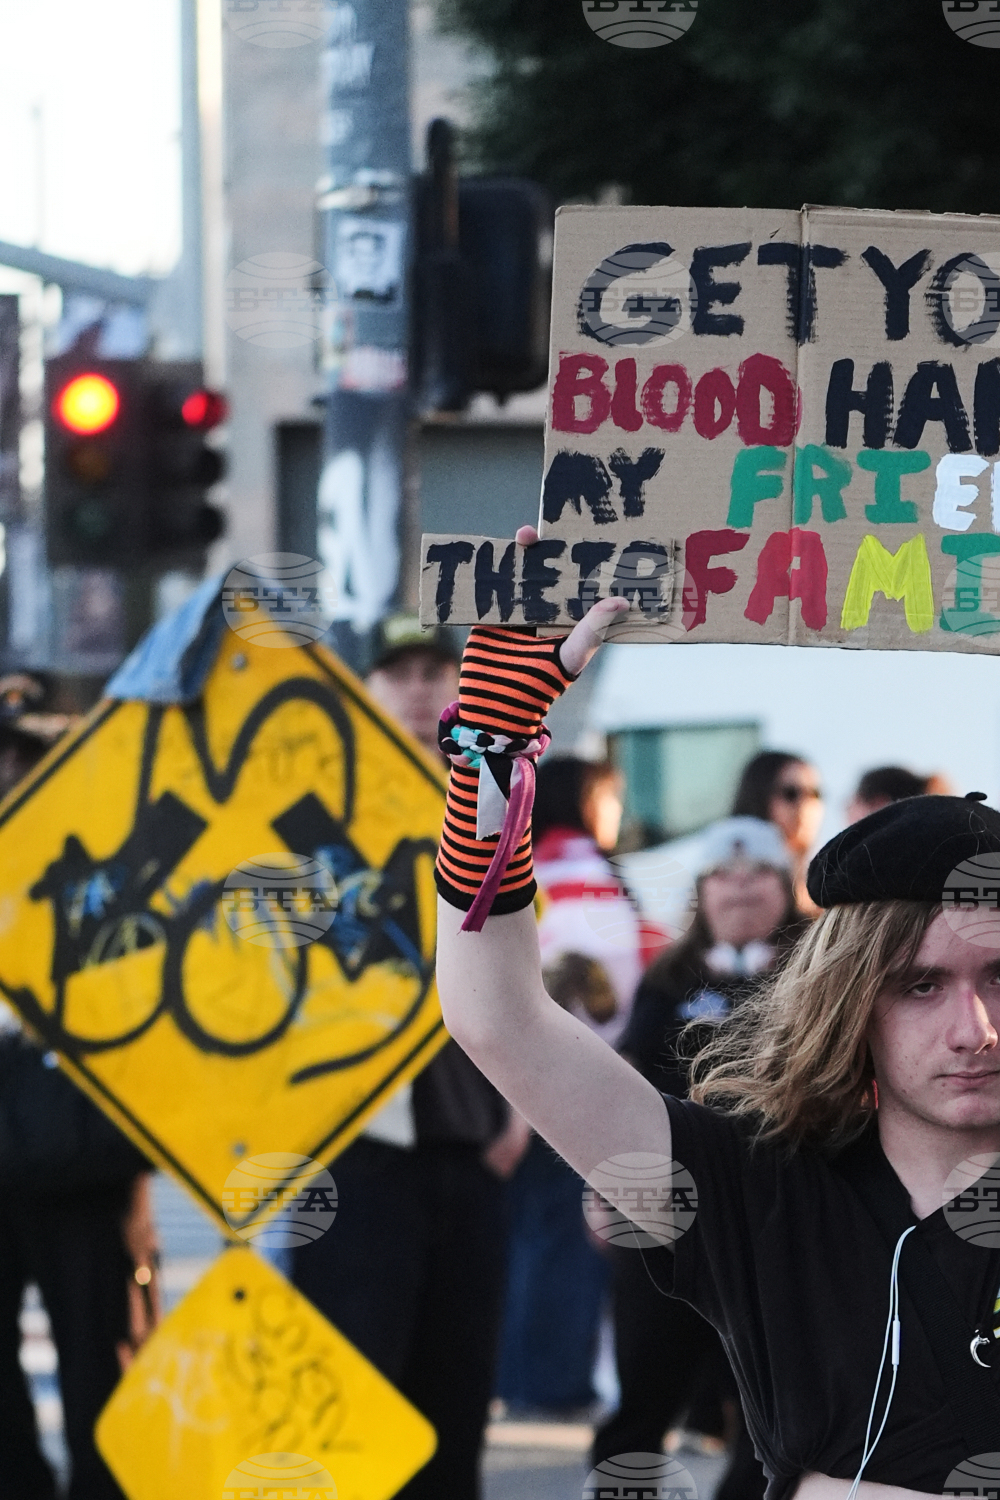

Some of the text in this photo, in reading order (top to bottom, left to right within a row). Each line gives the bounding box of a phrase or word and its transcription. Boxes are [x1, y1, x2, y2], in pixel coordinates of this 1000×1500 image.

[576, 241, 851, 347] GET
[551, 351, 803, 447] BLOOD
[542, 446, 666, 525] MY
[425, 538, 679, 624] THEIR
